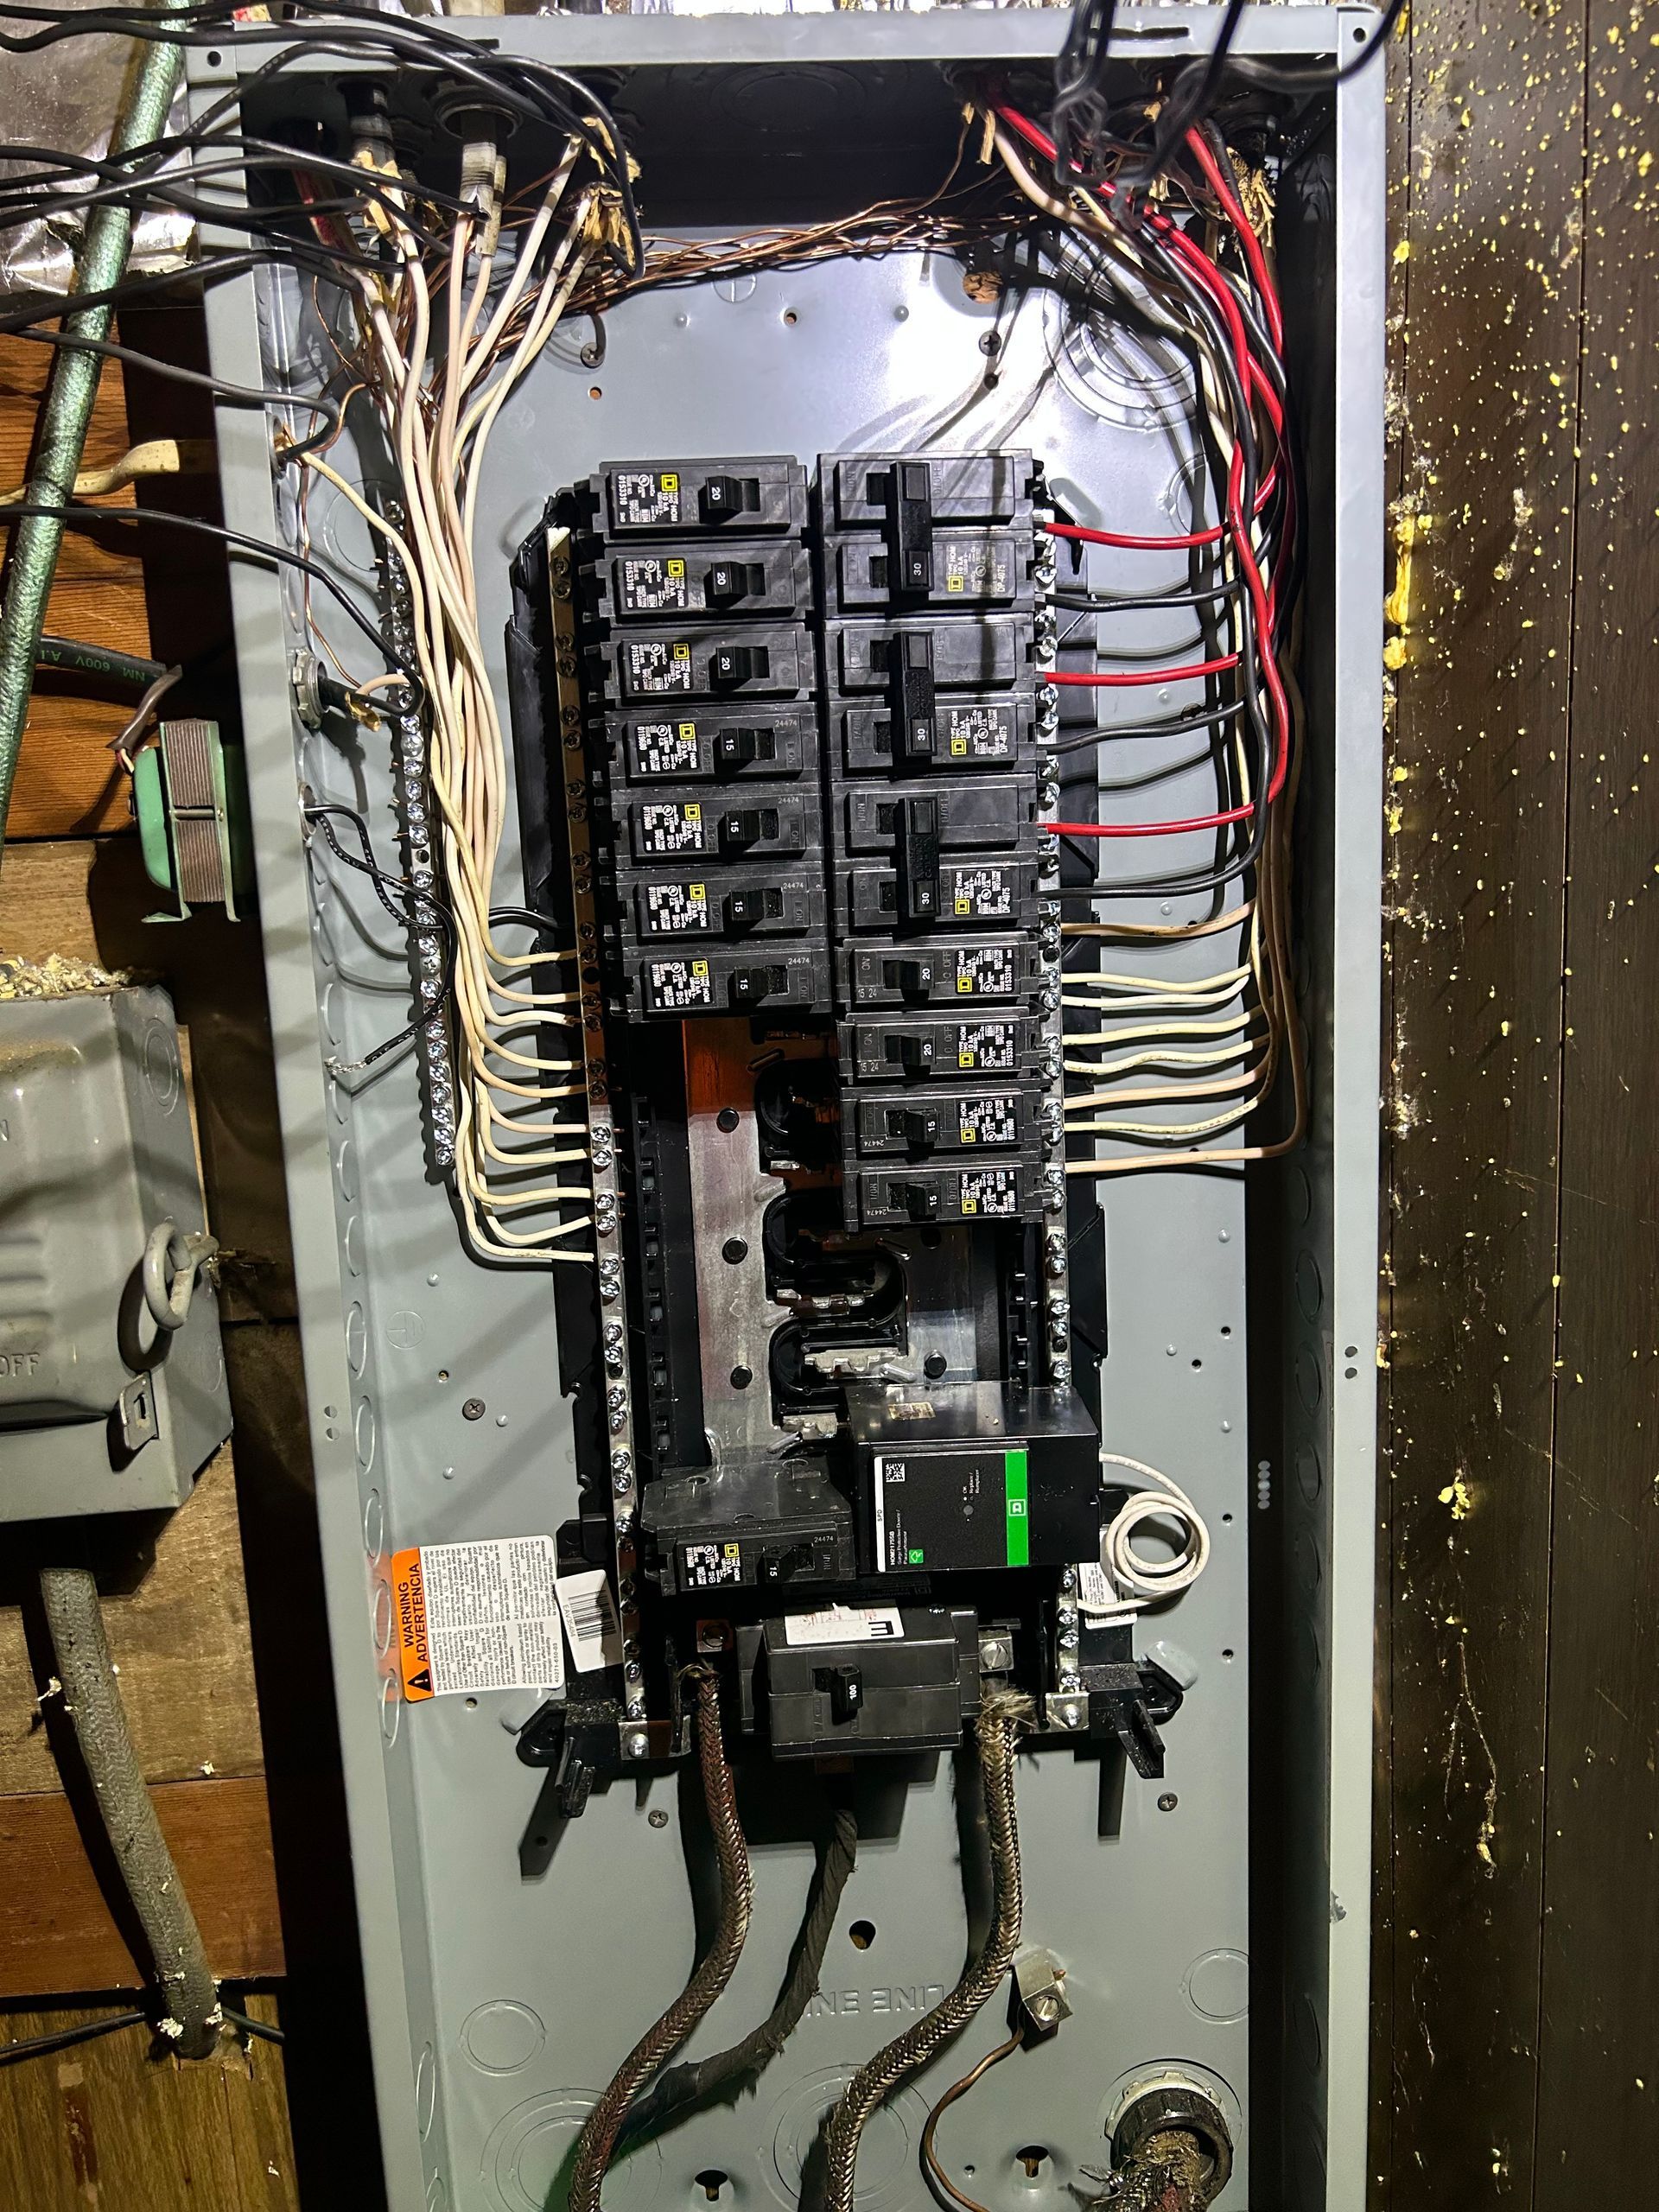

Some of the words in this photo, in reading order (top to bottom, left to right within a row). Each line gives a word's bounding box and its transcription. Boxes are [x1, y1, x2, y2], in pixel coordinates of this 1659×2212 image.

[618, 475, 627, 505] 0153310
[712, 487, 721, 500] 20
[663, 502, 669, 512] kA
[958, 556, 963, 565] kA
[914, 563, 921, 575] 30
[625, 562, 634, 590] 0153310
[717, 572, 726, 586] 20
[670, 588, 676, 596] kA
[75, 656, 110, 672] 600V
[631, 645, 640, 674] 0153310
[721, 657, 729, 671] 20
[123, 668, 146, 681] NM
[675, 671, 682, 679] kA
[960, 720, 965, 729] kA
[918, 728, 925, 741] 30
[999, 726, 1007, 753] DP-4075
[726, 739, 734, 751] 15
[682, 750, 688, 759] kA
[730, 821, 739, 833] 15
[687, 830, 693, 839] kA
[922, 893, 929, 904] 30
[734, 900, 742, 912] 15
[966, 959, 971, 968] kA
[922, 968, 930, 979] 20
[740, 979, 747, 989] 15
[859, 988, 864, 998] 15
[869, 988, 876, 998] 24
[924, 1045, 931, 1055] 20
[861, 1062, 867, 1072] 15
[871, 1061, 879, 1071] 24
[928, 1121, 935, 1131] 15
[930, 1195, 937, 1206] 15
[770, 1567, 777, 1576] 15
[398, 1582, 414, 1647] WARNING
[409, 1563, 428, 1662] ADVERTENCIA
[872, 1985, 944, 2012] LINE
